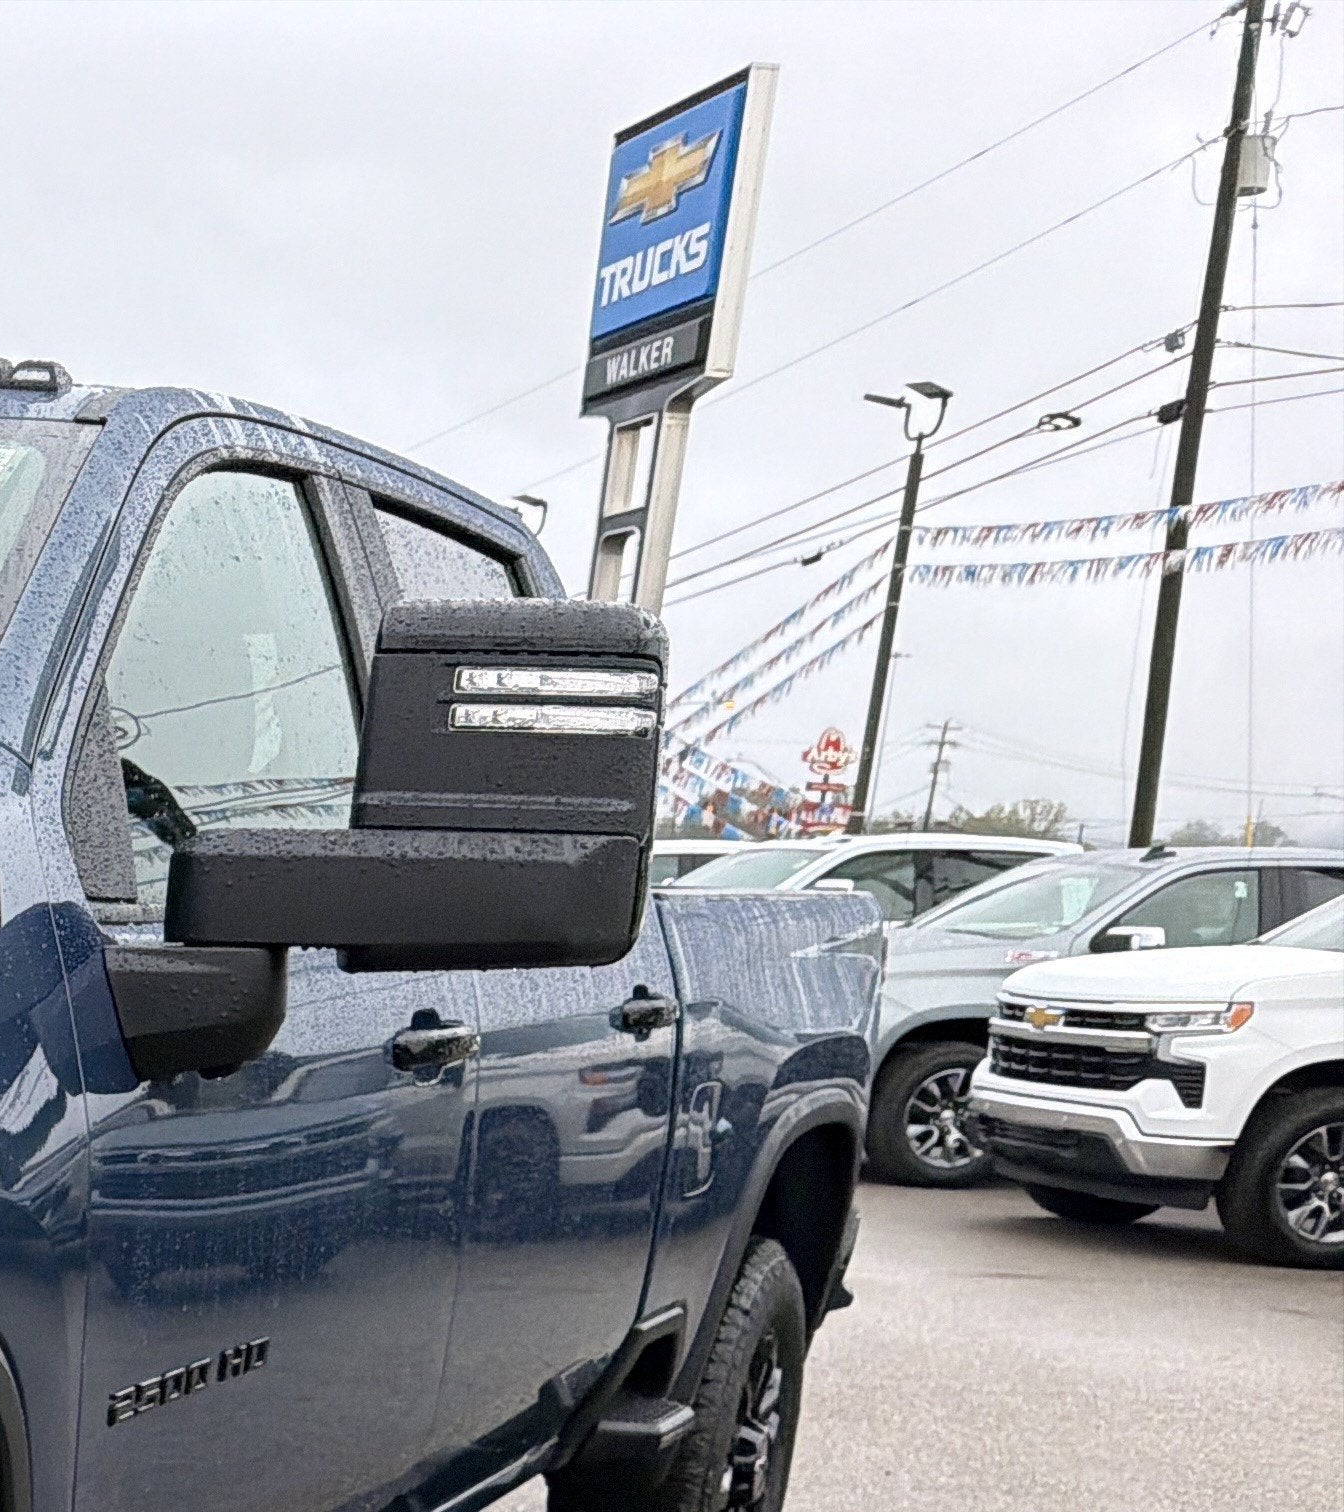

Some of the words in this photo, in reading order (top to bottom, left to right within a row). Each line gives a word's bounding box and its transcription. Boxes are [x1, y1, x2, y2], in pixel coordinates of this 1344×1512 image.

[600, 222, 711, 308] TRUCKS
[606, 336, 675, 385] WALKER
[107, 1356, 212, 1426] 2500
[217, 1336, 271, 1382] HD
